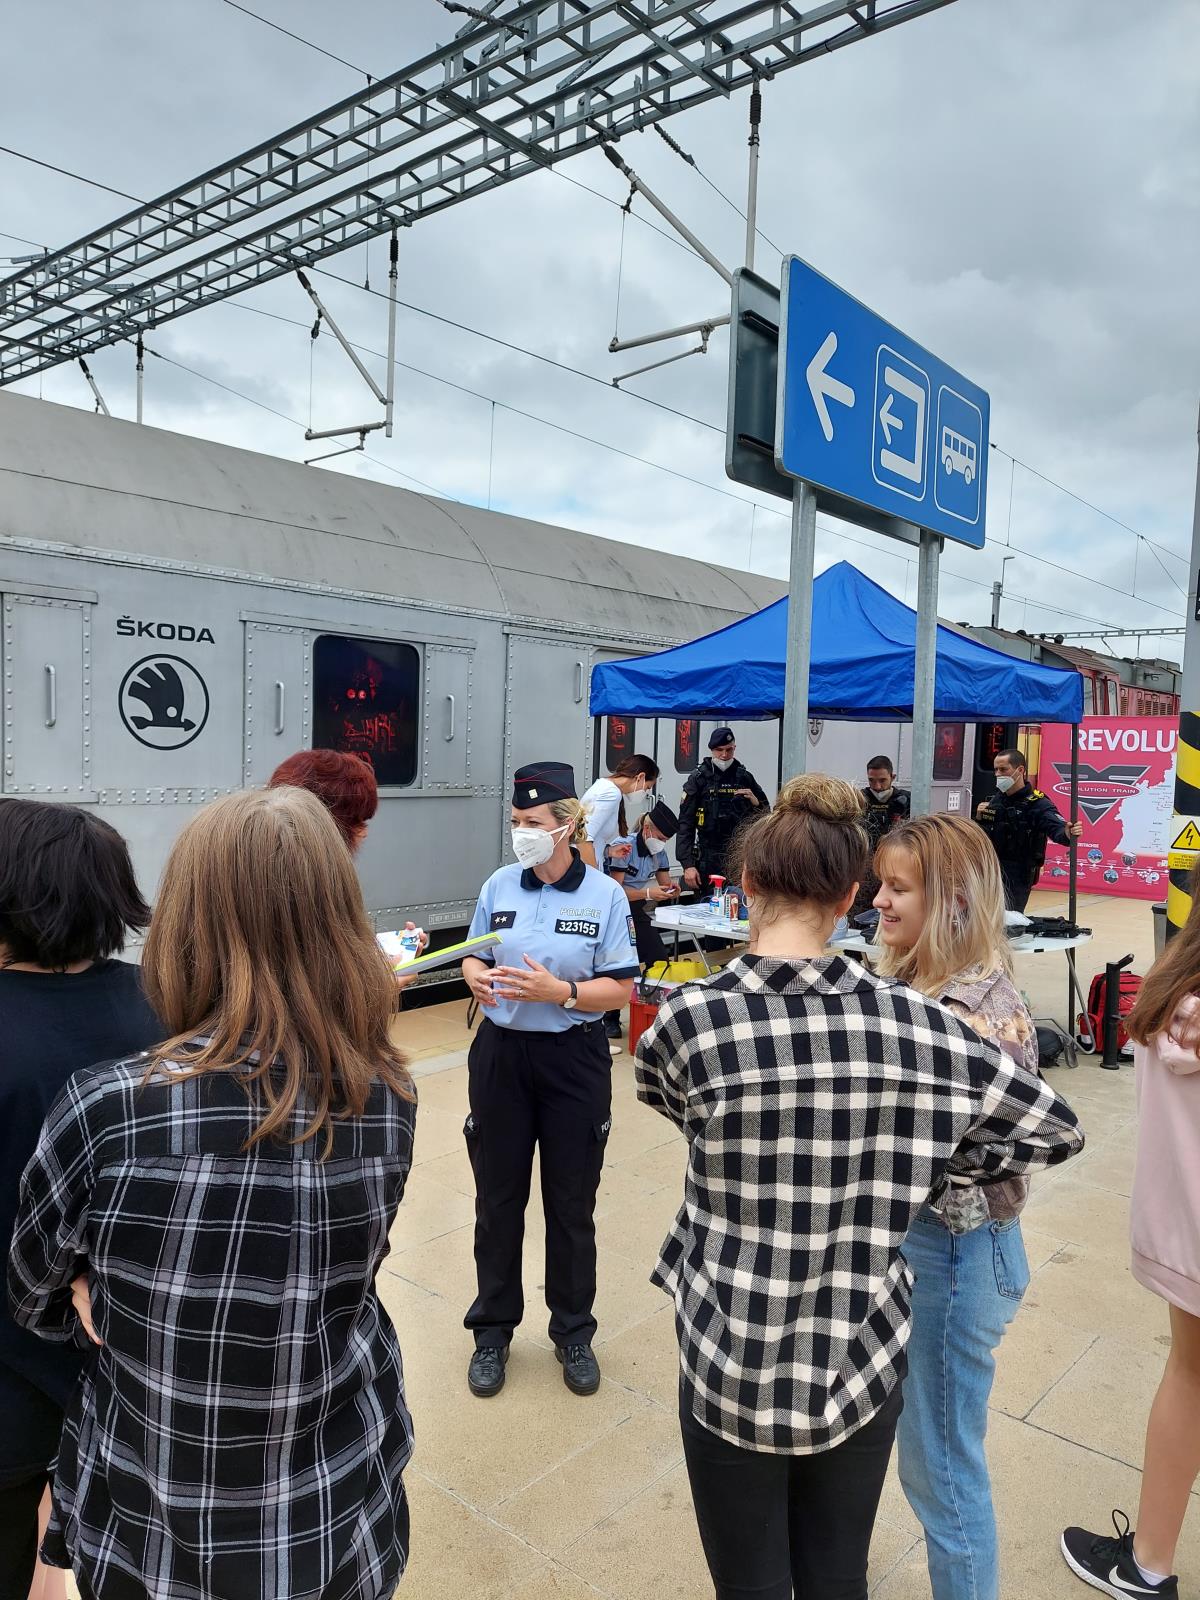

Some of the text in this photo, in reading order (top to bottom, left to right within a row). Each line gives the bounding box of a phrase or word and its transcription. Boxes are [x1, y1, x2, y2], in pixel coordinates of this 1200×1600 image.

[116, 615, 215, 644] ŠKODA
[1070, 729, 1179, 753] REVOLU
[560, 907, 602, 919] POLICIE
[558, 921, 597, 936] 323155
